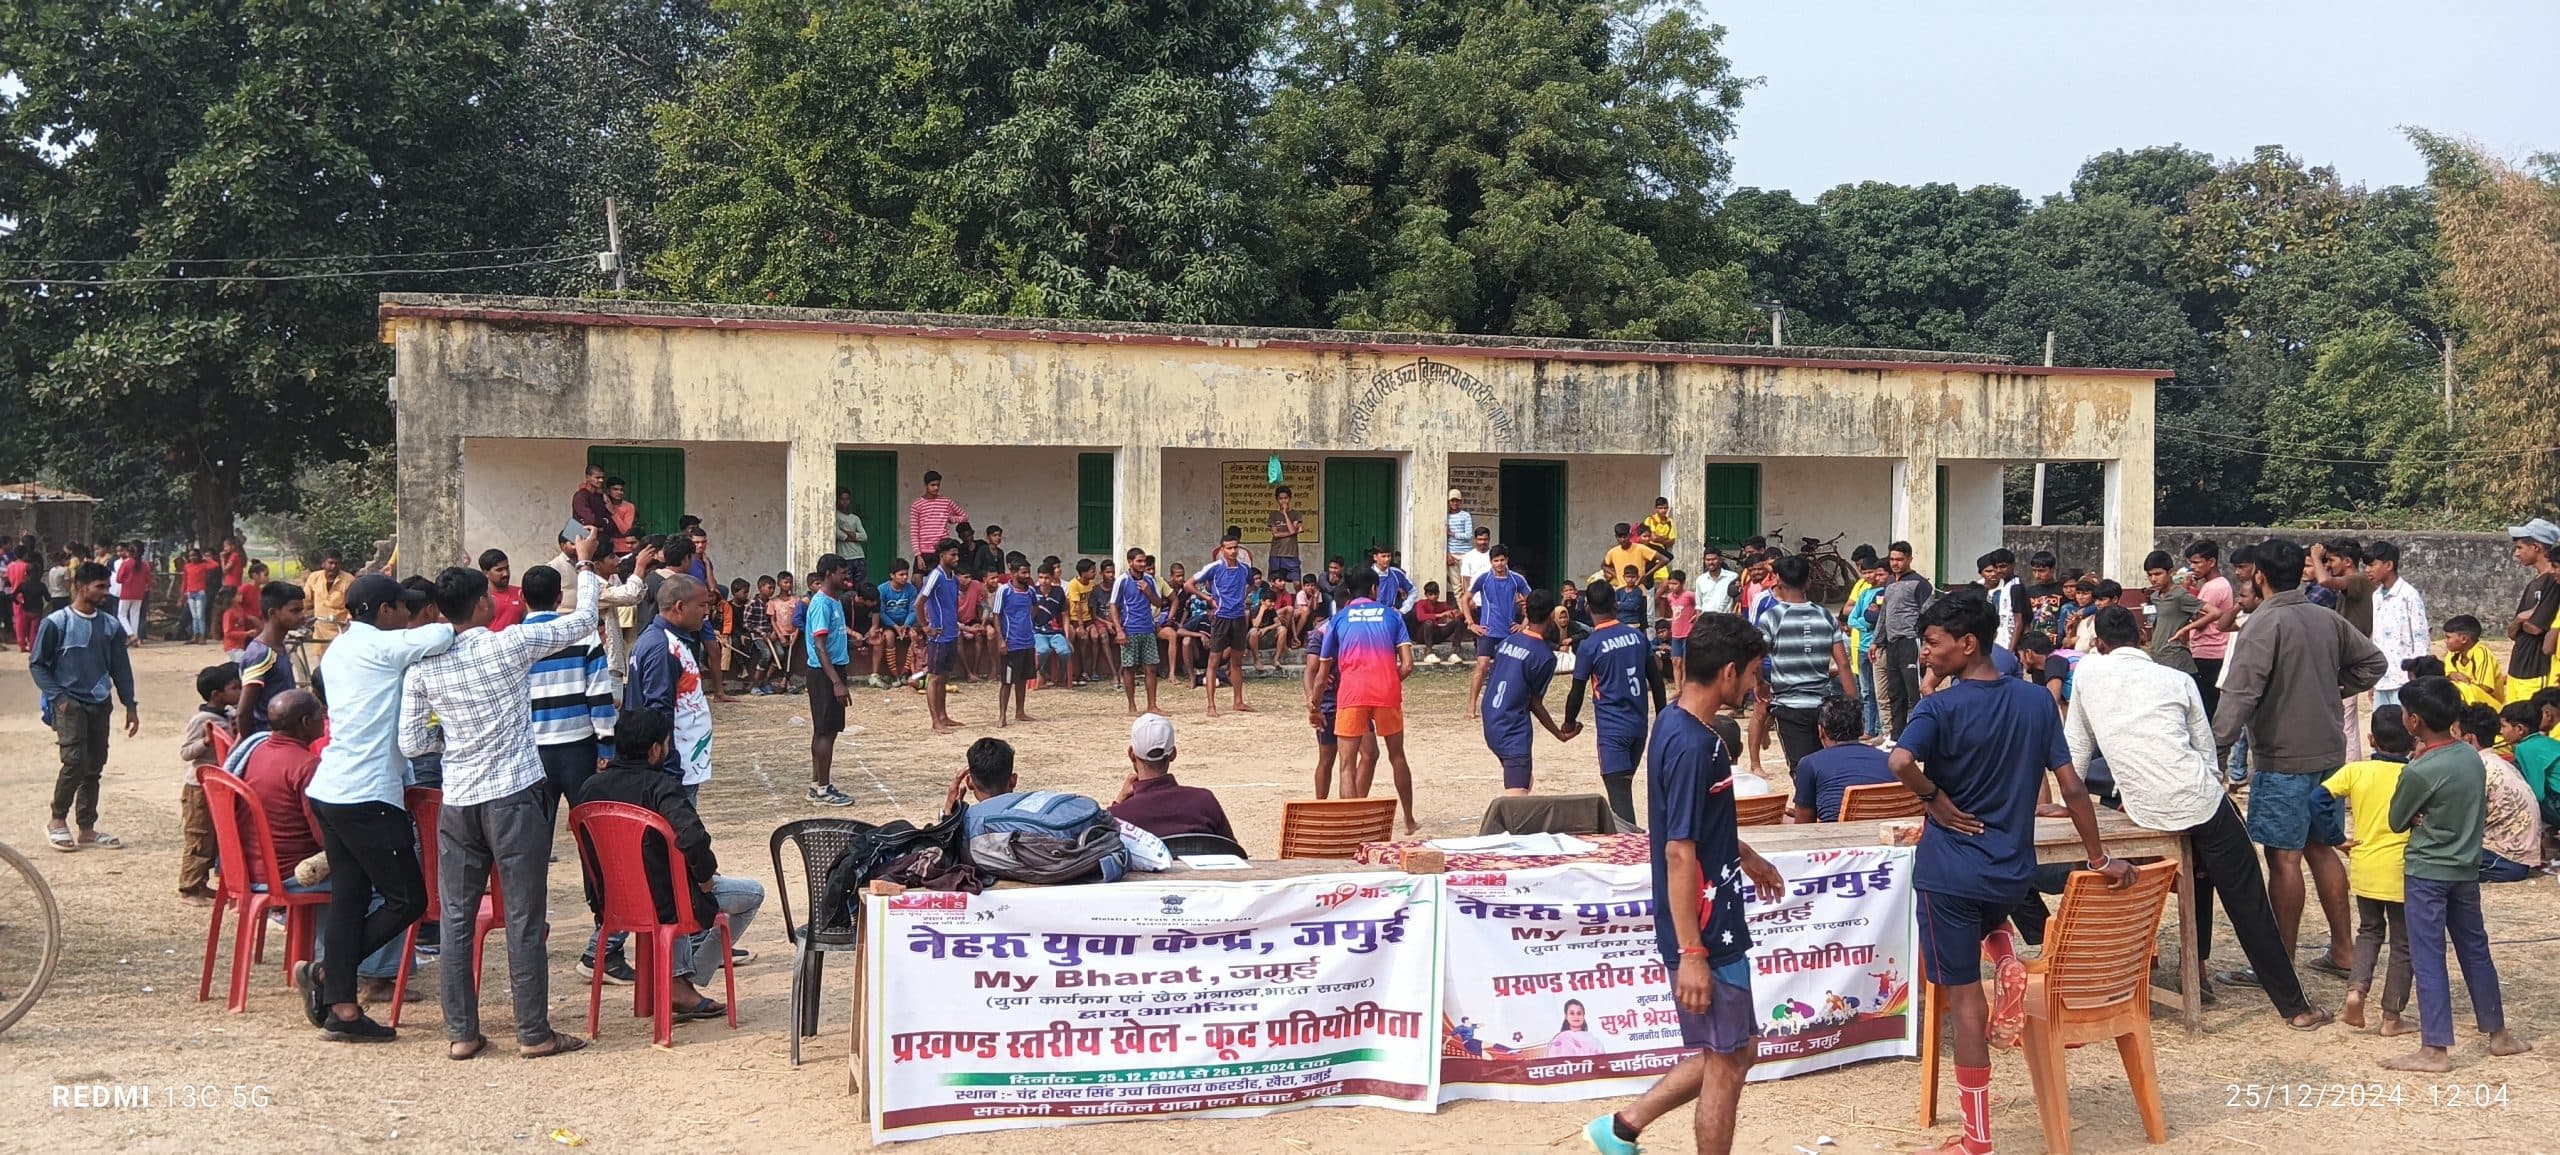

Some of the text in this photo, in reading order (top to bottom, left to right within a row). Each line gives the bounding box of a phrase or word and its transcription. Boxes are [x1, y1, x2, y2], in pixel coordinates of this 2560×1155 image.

[1348, 607, 1385, 617] KEI
[1601, 633, 1641, 653] JAMUI
[1626, 666, 1641, 697] 5
[1788, 861, 1893, 898] जमुई
[1041, 933, 1142, 966] युवा
[1291, 907, 1410, 954] जमुई
[1511, 927, 1567, 941] My
[1567, 939, 1630, 951] कार्यक्रम
[1812, 917, 1870, 931] सरकार)
[974, 971, 1039, 992] My
[1228, 955, 1321, 984] जमुई
[1492, 972, 1563, 998] प्रखण्ड
[1566, 962, 1634, 991] स्तरीय
[1755, 942, 1876, 976] प्रतियोगिता
[986, 995, 1033, 1010] (युवा
[1039, 993, 1112, 1006] कार्यक्रम
[1119, 991, 1146, 1004] एवं
[1152, 991, 1188, 1003] खेल
[1316, 977, 1376, 993] सरकार)
[1077, 1001, 1258, 1019] द्वारा आयोजित
[1598, 1008, 1638, 1035] सुश्री
[891, 1031, 1000, 1064] प्रखण्ड
[1006, 1020, 1103, 1058] स्तरीय
[1109, 1018, 1181, 1055] खेल
[1203, 1021, 1260, 1061] कूद
[1266, 1000, 1423, 1048] प्रतियोगिता
[1628, 1029, 1660, 1041] माननीय
[1527, 1059, 1594, 1079] सहयोगी
[1608, 1053, 1680, 1073] साईकिल
[1757, 1041, 1804, 1057] विचार,
[1807, 1030, 1842, 1050] जमुई
[955, 1089, 998, 1100] स्थान
[1041, 1086, 1083, 1099] शेखर
[1086, 1084, 1114, 1099] सिंह
[1118, 1085, 1143, 1098] उच्च
[1147, 1080, 1201, 1096] विद्यालय
[1301, 1068, 1332, 1084] जमुई
[1009, 1074, 1077, 1085] दिनांक
[1097, 1069, 1186, 1083] 25.12.2024
[1189, 1068, 1209, 1079] से
[1213, 1063, 1295, 1076] 26.12.2024
[1299, 1057, 1332, 1070] तक
[972, 1103, 1052, 1117] सहयोगी
[1070, 1102, 1155, 1116] साईकिल
[1159, 1099, 1204, 1111] यात्रा
[1206, 1098, 1238, 1108] एक
[1242, 1091, 1297, 1104] विचार,
[1300, 1081, 1344, 1098] जमुई
